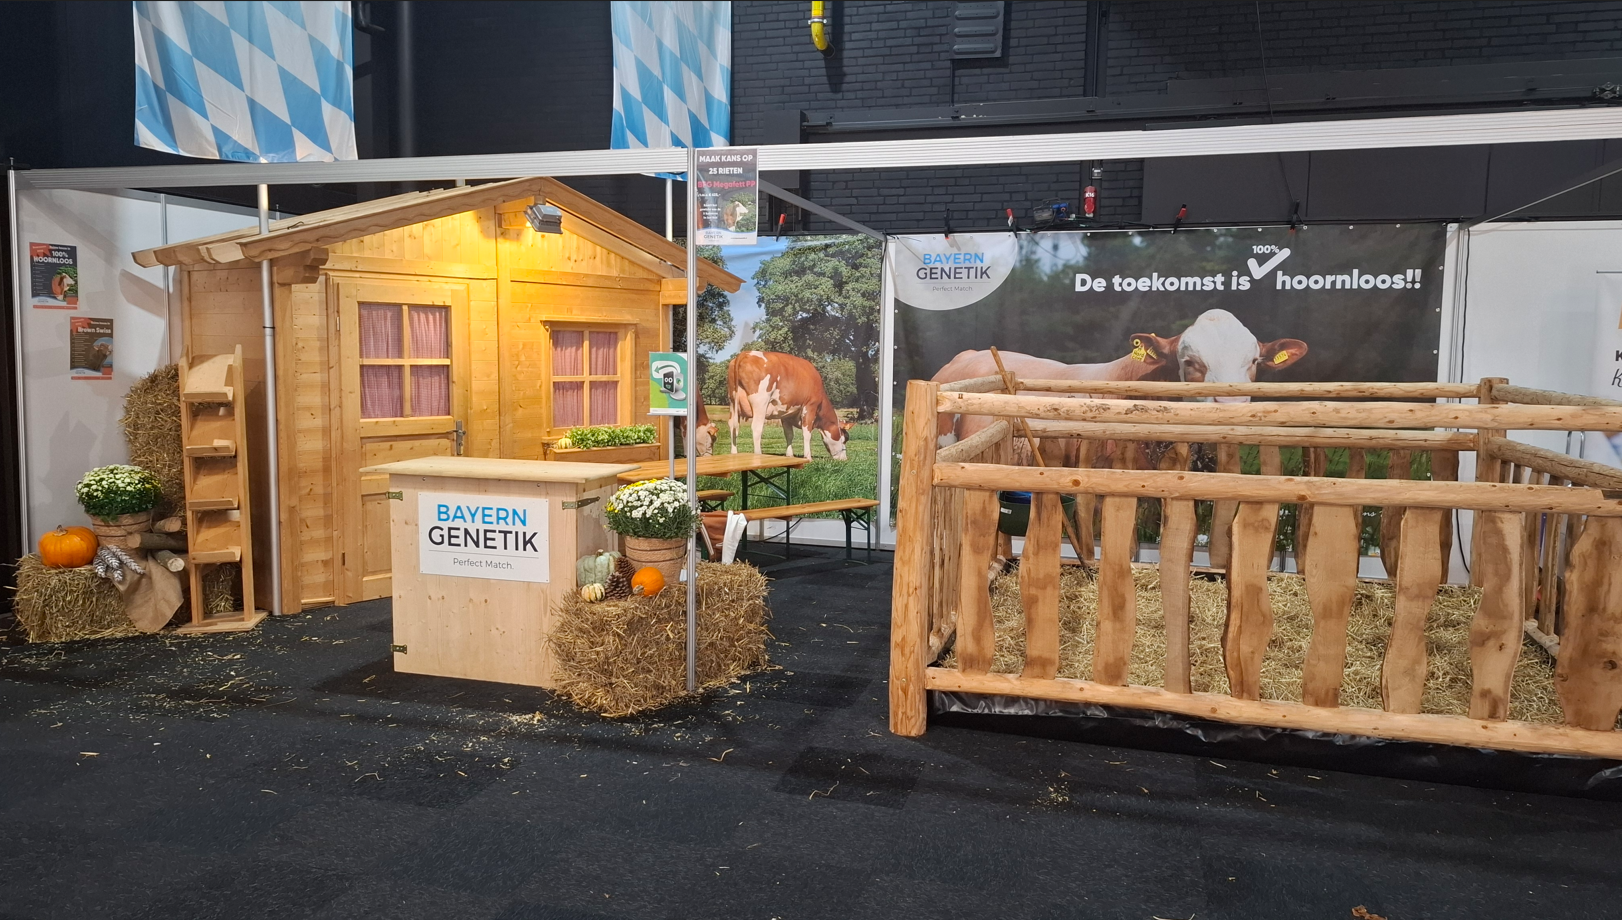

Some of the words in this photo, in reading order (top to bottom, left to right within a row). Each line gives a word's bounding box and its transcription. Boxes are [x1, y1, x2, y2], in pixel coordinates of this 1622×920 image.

[1252, 244, 1280, 254] 100%
[33, 256, 73, 264] HOORNLOOS
[923, 252, 984, 265] BAYERN
[916, 266, 991, 280] GENETIK
[1074, 273, 1107, 292] De
[1112, 272, 1225, 292] toekomst
[1231, 270, 1251, 291] is
[1275, 268, 1422, 290] hoornloos!!
[437, 504, 527, 527] BAYERN
[428, 525, 539, 553] GENETIK
[453, 557, 483, 568] Perfect
[485, 560, 514, 570] Match.
